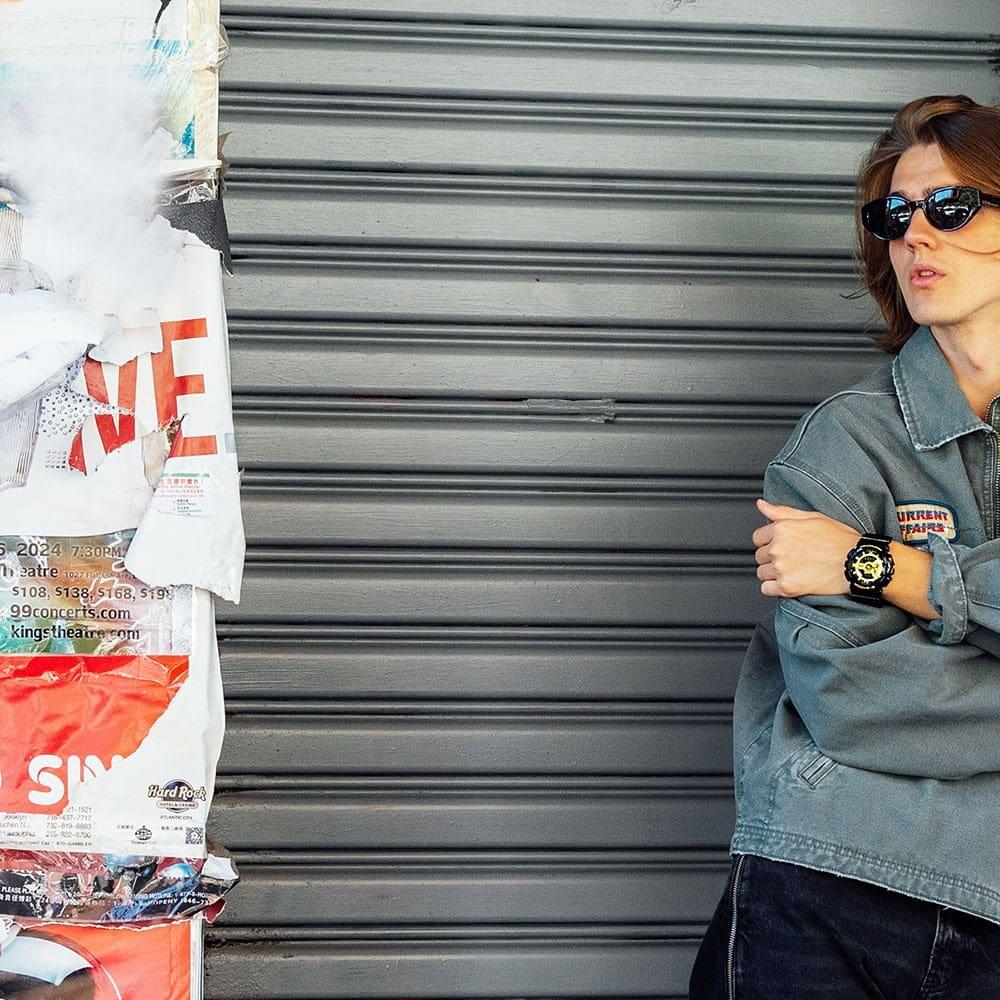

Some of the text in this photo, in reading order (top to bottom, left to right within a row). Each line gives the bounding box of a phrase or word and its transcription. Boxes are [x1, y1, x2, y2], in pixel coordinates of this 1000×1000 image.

[896, 510, 949, 522] URRENT
[17, 543, 62, 557] 2024
[72, 546, 121, 558] 7:30PM
[10, 604, 131, 619] 99concerts.com
[147, 784, 207, 801] Hard Rock
